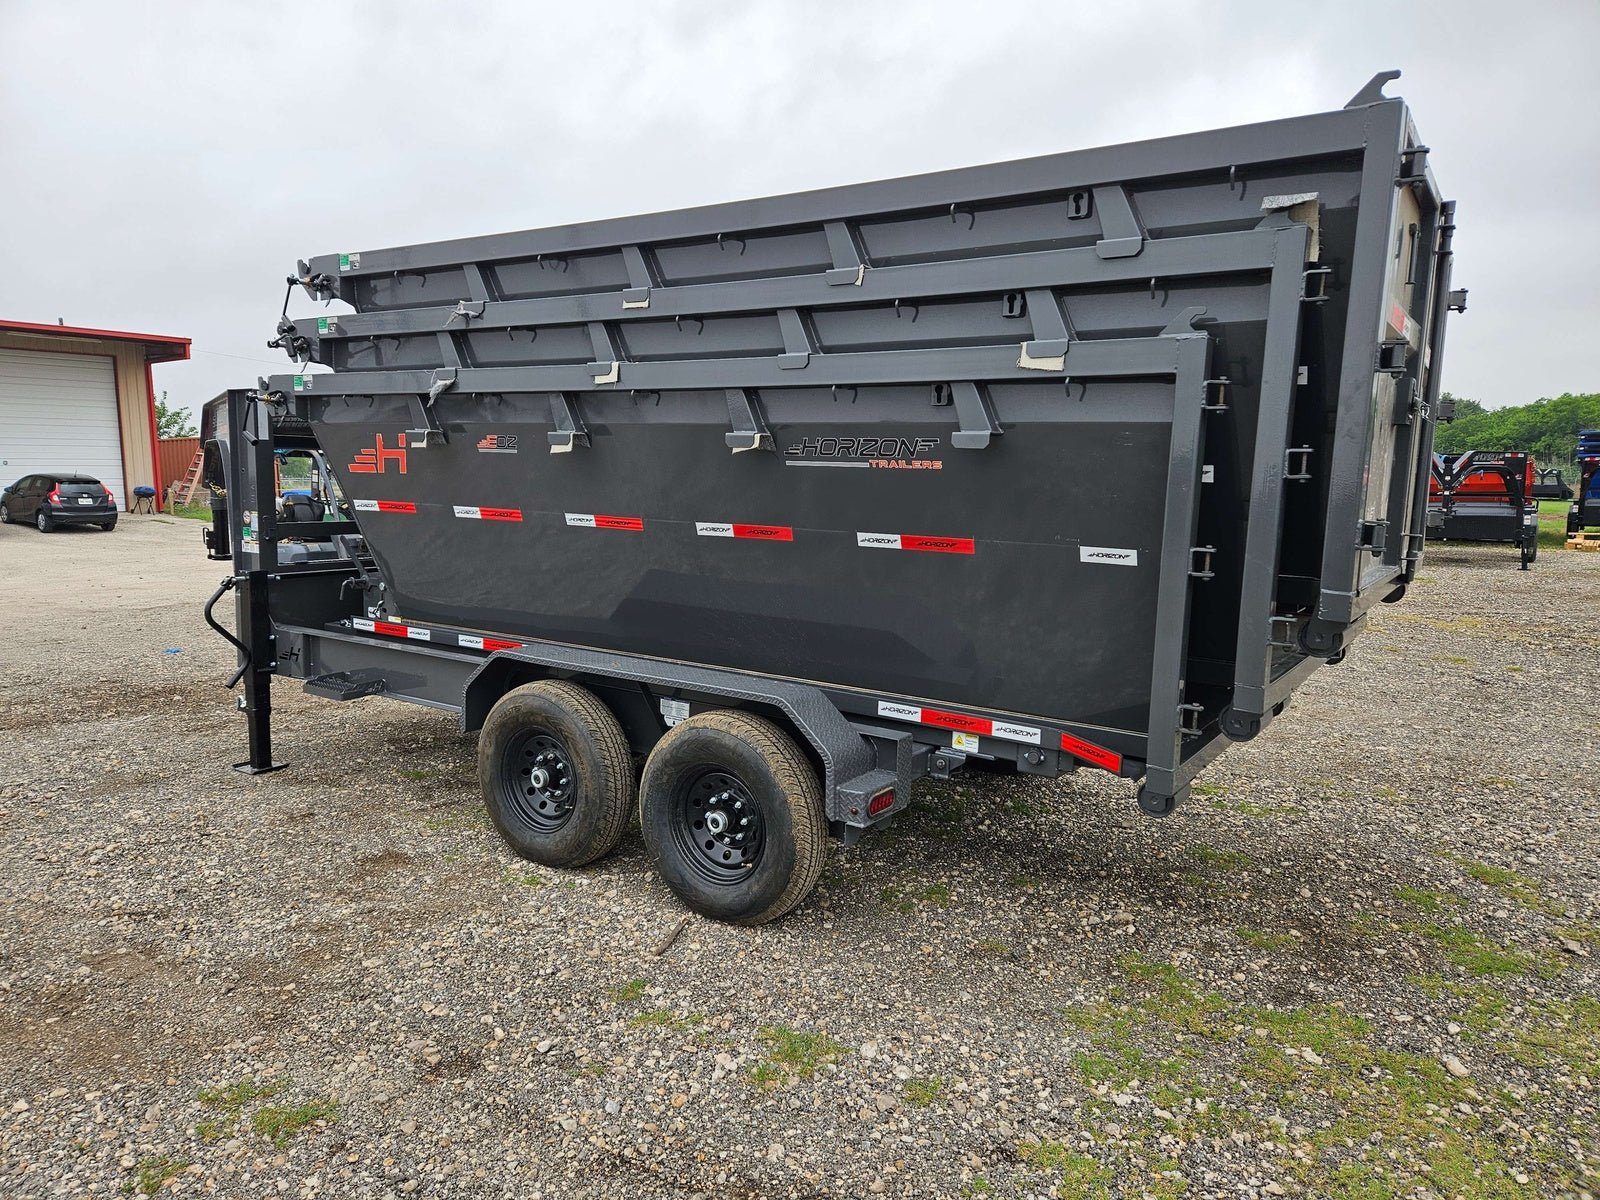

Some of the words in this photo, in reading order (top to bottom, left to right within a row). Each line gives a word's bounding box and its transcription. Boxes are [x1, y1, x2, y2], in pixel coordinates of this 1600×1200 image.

[794, 437, 928, 458] HORIZON
[868, 459, 943, 470] TRAILERS
[917, 540, 957, 548] HORIZON
[1088, 552, 1131, 560] HORIZON
[881, 706, 919, 715] HORIZON
[995, 726, 1039, 737] HORIZON
